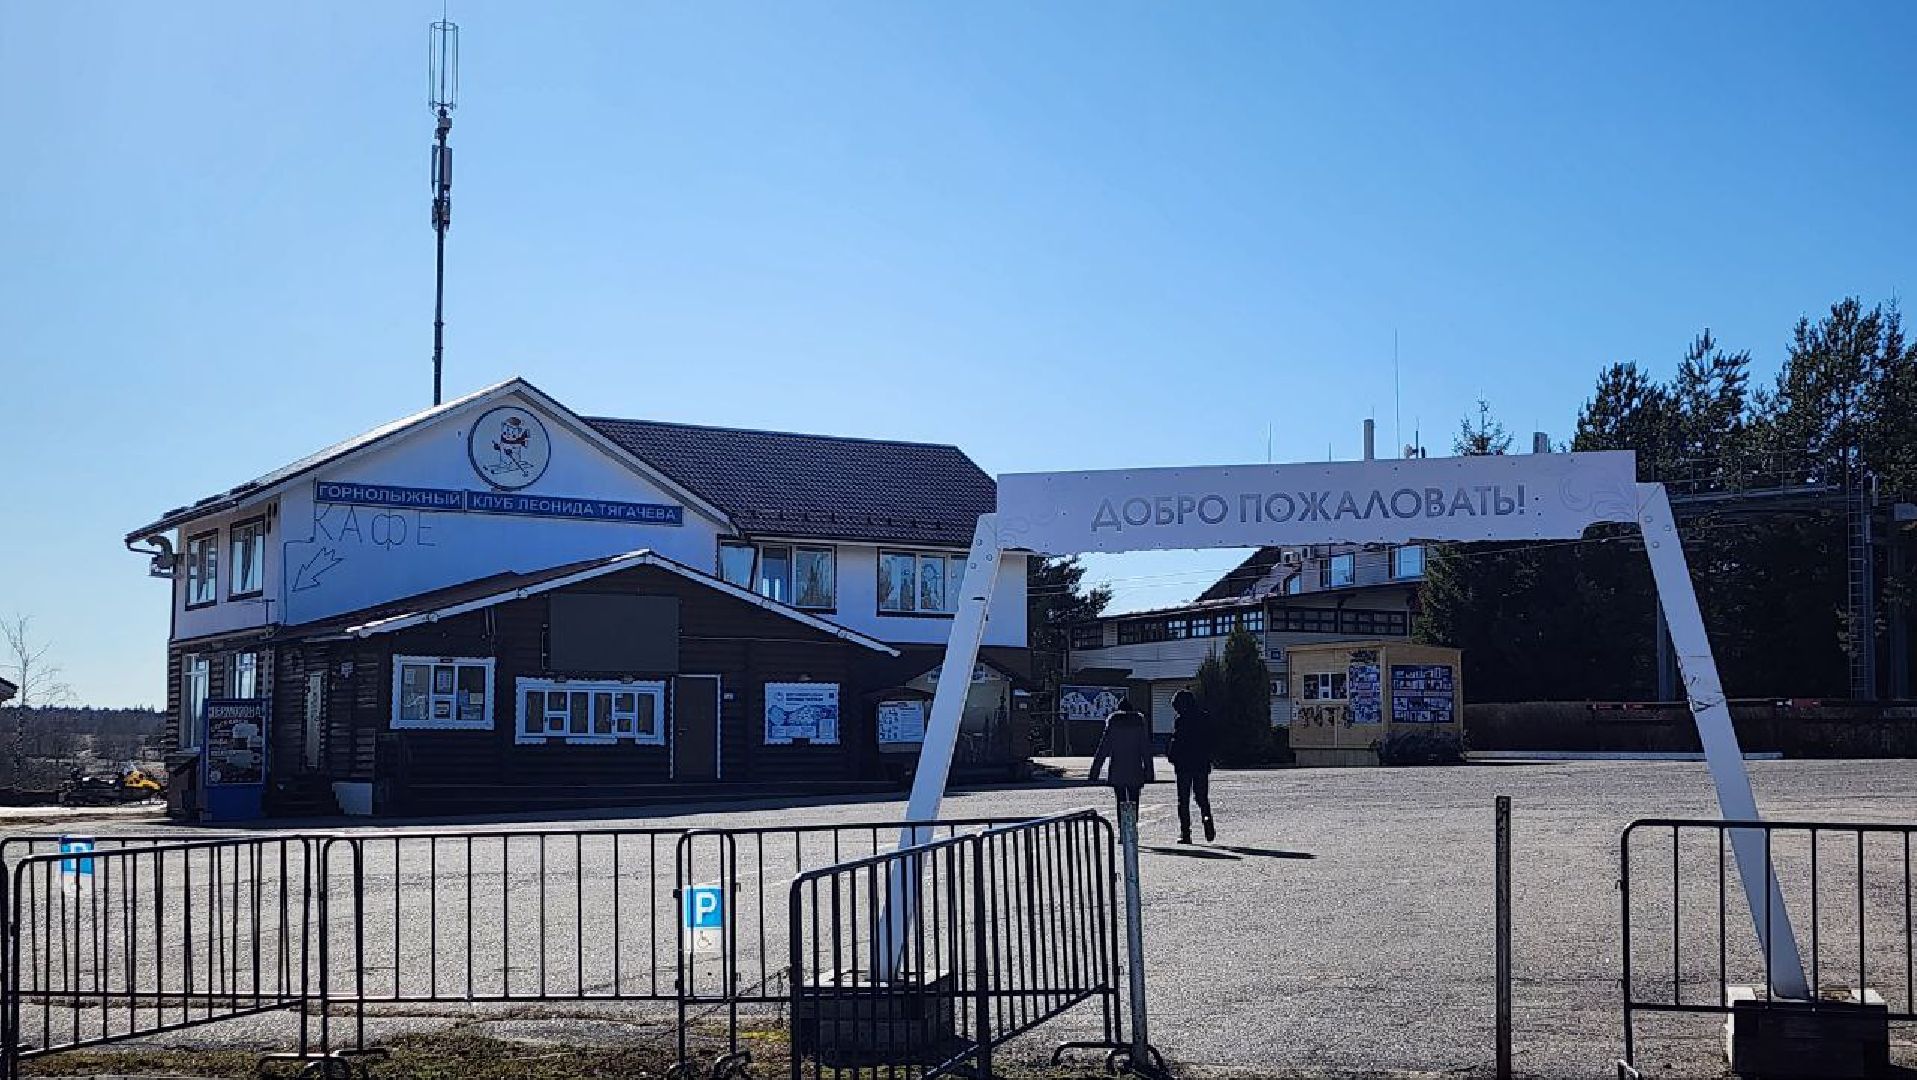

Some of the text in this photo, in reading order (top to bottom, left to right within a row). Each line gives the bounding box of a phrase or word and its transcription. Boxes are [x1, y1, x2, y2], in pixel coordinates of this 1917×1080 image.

[313, 502, 436, 551] КАФЕ
[318, 484, 677, 521] ГОРНОЛЫЖНЫЙ КЛУБ ЛЕОНИДА ТЯГАЧЕВА
[1090, 484, 1526, 532] ДОБРО ПОЖАЛОВАТЬ!
